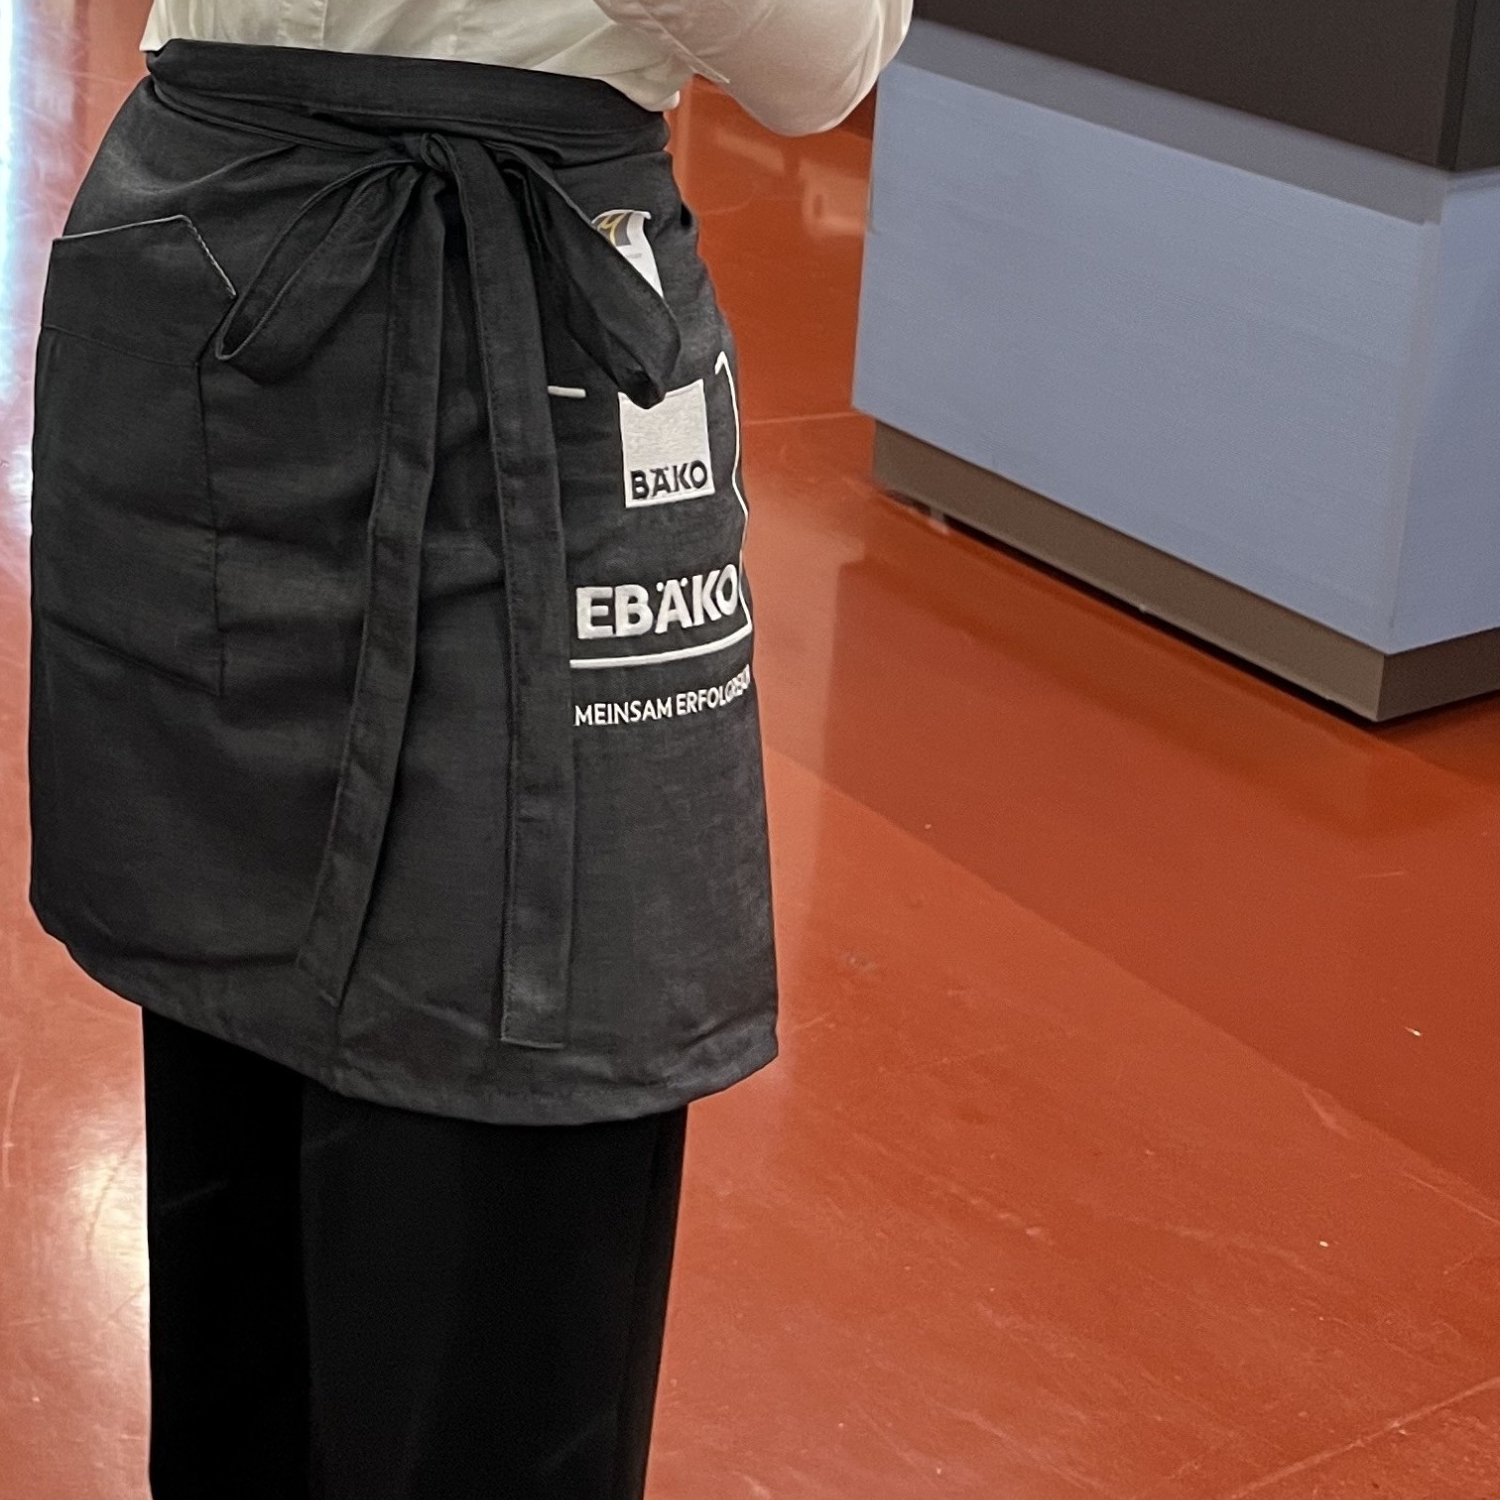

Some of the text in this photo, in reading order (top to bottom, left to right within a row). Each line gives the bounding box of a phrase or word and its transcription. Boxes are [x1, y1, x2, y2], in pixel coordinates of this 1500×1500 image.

[630, 460, 708, 500] BÄKO
[576, 564, 738, 639] EBÄKO
[574, 697, 673, 726] MEINSAM
